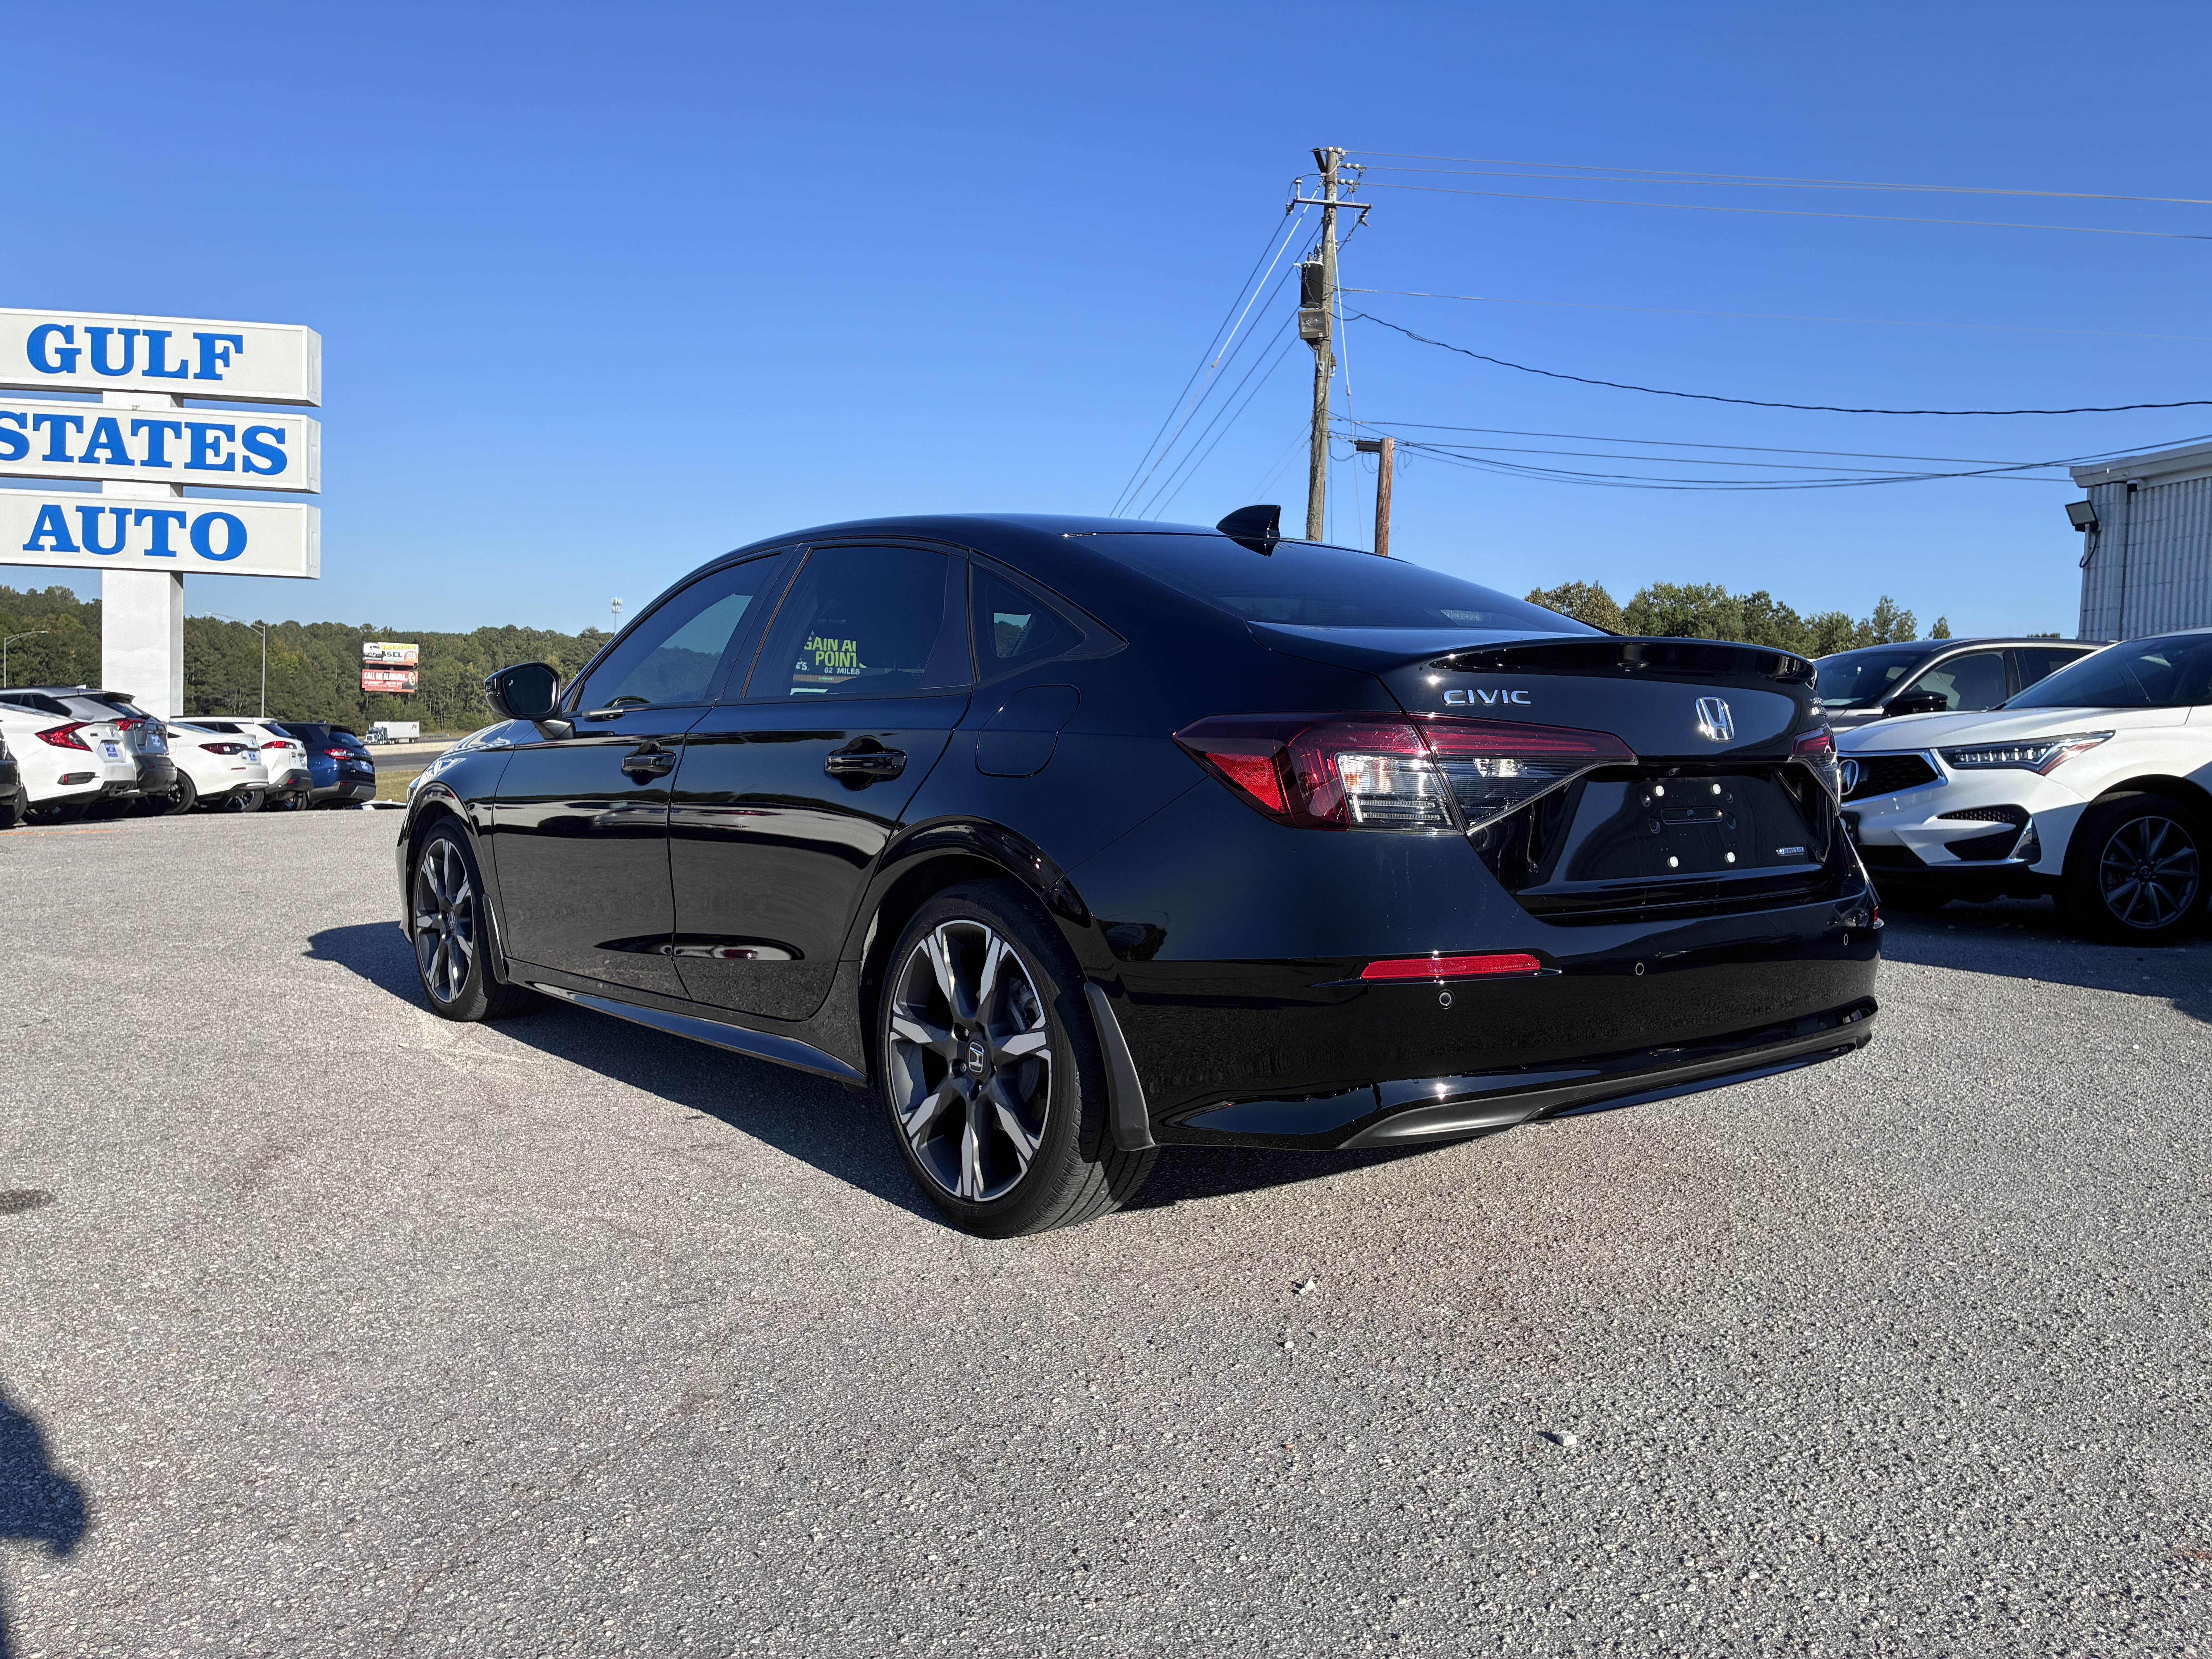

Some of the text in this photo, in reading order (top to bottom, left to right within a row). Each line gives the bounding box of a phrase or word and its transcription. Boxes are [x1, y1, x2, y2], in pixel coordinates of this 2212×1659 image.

[27, 324, 243, 381] GULF
[0, 410, 287, 476] STATES
[22, 504, 247, 561] AUTO
[1443, 689, 1531, 705] CIVIC
[976, 897, 1017, 930] Continental
